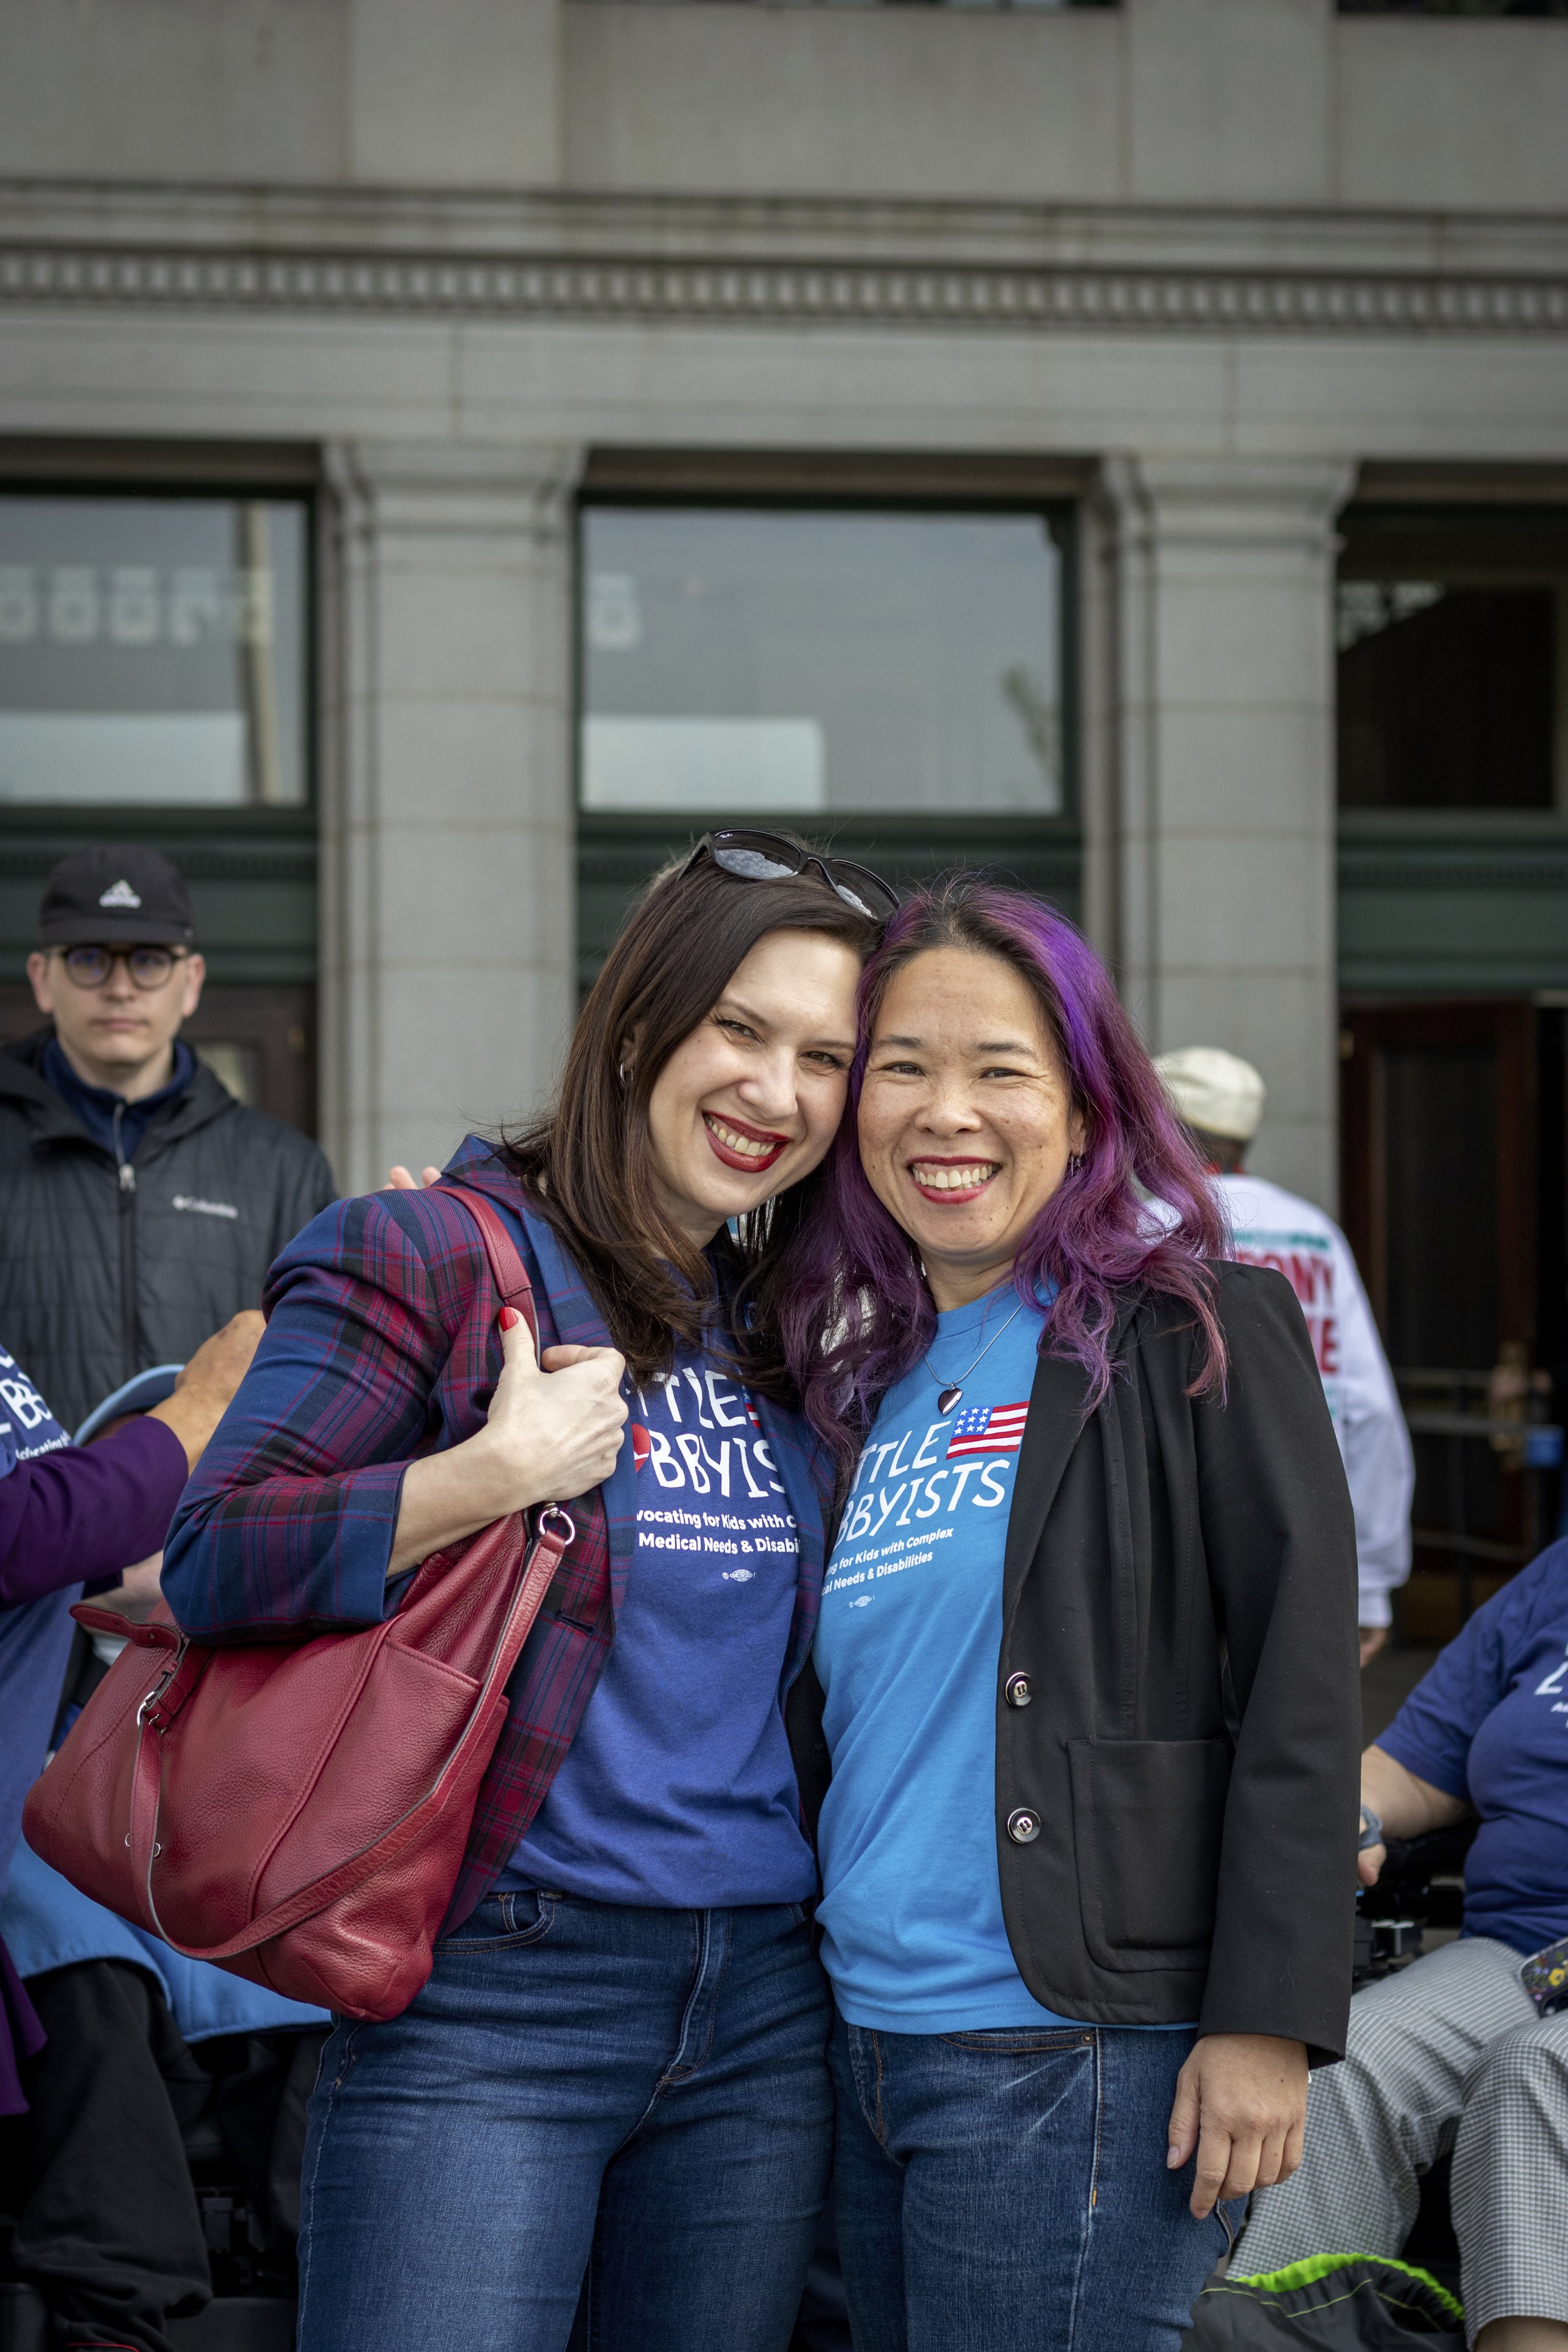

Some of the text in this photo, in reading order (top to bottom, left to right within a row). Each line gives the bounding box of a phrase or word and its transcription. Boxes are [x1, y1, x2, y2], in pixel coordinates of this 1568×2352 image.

[702, 1512, 720, 1527] for
[721, 1513, 746, 1530] Kids
[748, 1514, 785, 1529] with
[638, 1532, 800, 1555] Medical Needs & Disabi
[839, 1557, 854, 1569] for
[855, 1549, 879, 1564] Kids
[881, 1540, 904, 1557] with
[906, 1528, 954, 1549] Complex
[834, 1571, 866, 1591] Needs
[867, 1567, 874, 1581] &
[876, 1551, 933, 1578] Disabilities
